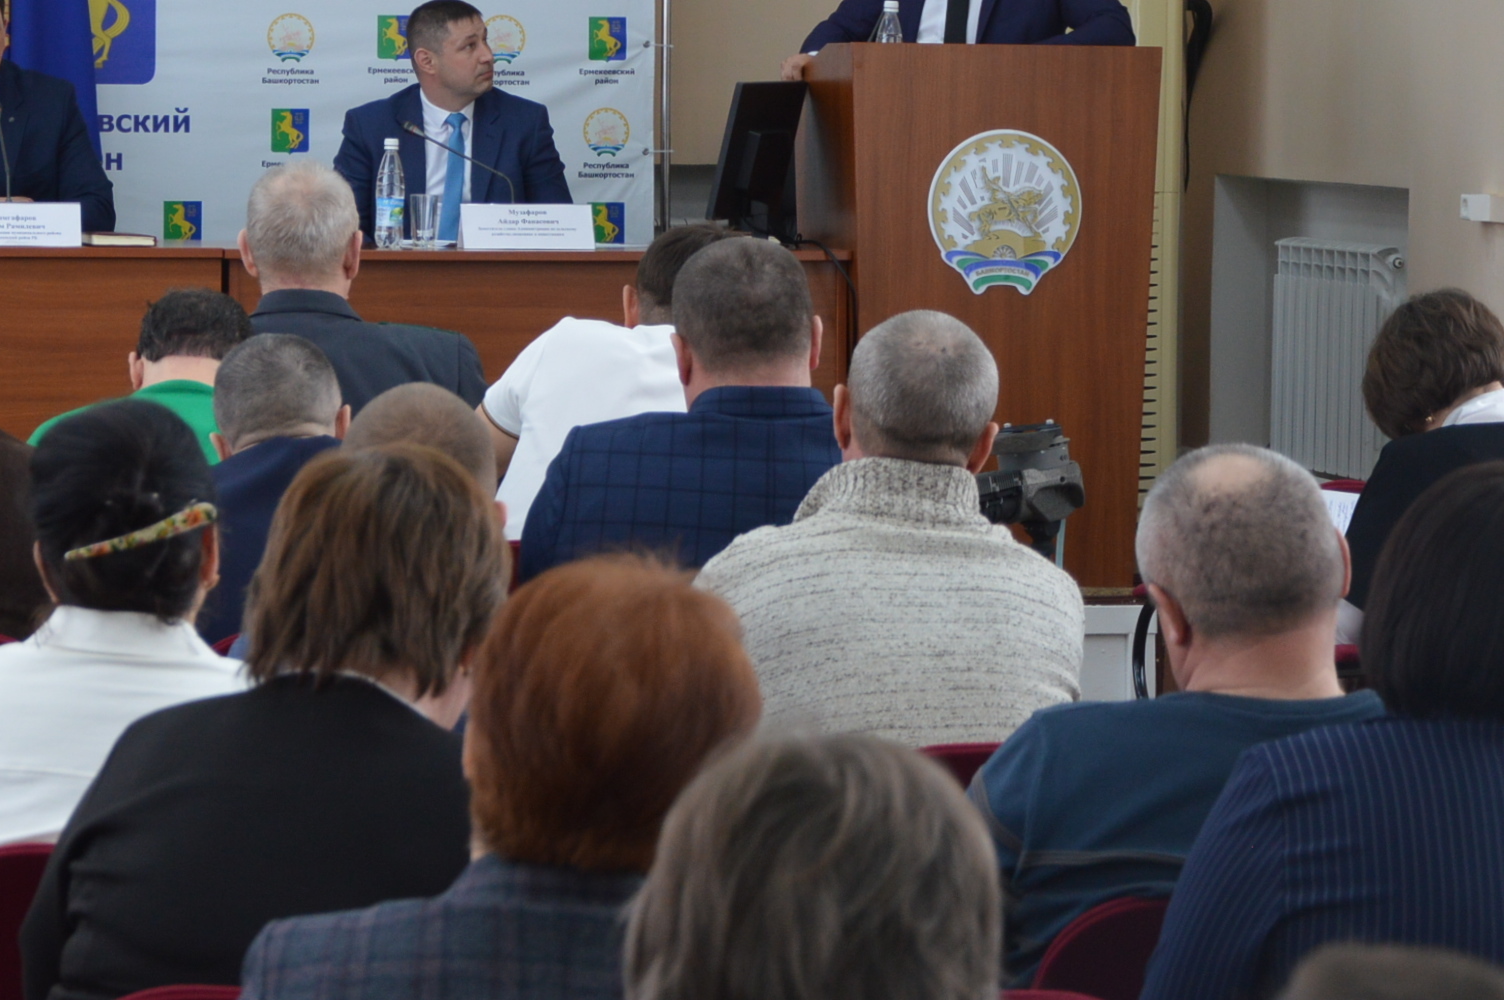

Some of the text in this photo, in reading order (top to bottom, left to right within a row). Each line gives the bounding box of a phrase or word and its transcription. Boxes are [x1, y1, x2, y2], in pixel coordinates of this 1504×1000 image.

[266, 67, 315, 77] Республика
[367, 65, 415, 76] Ермекеевск
[578, 67, 636, 77] Ермекеевский
[261, 76, 320, 86] Башкортостан
[383, 75, 409, 85] район
[594, 76, 619, 86] район
[582, 161, 630, 171] Республика
[577, 170, 635, 181] Башкортостан
